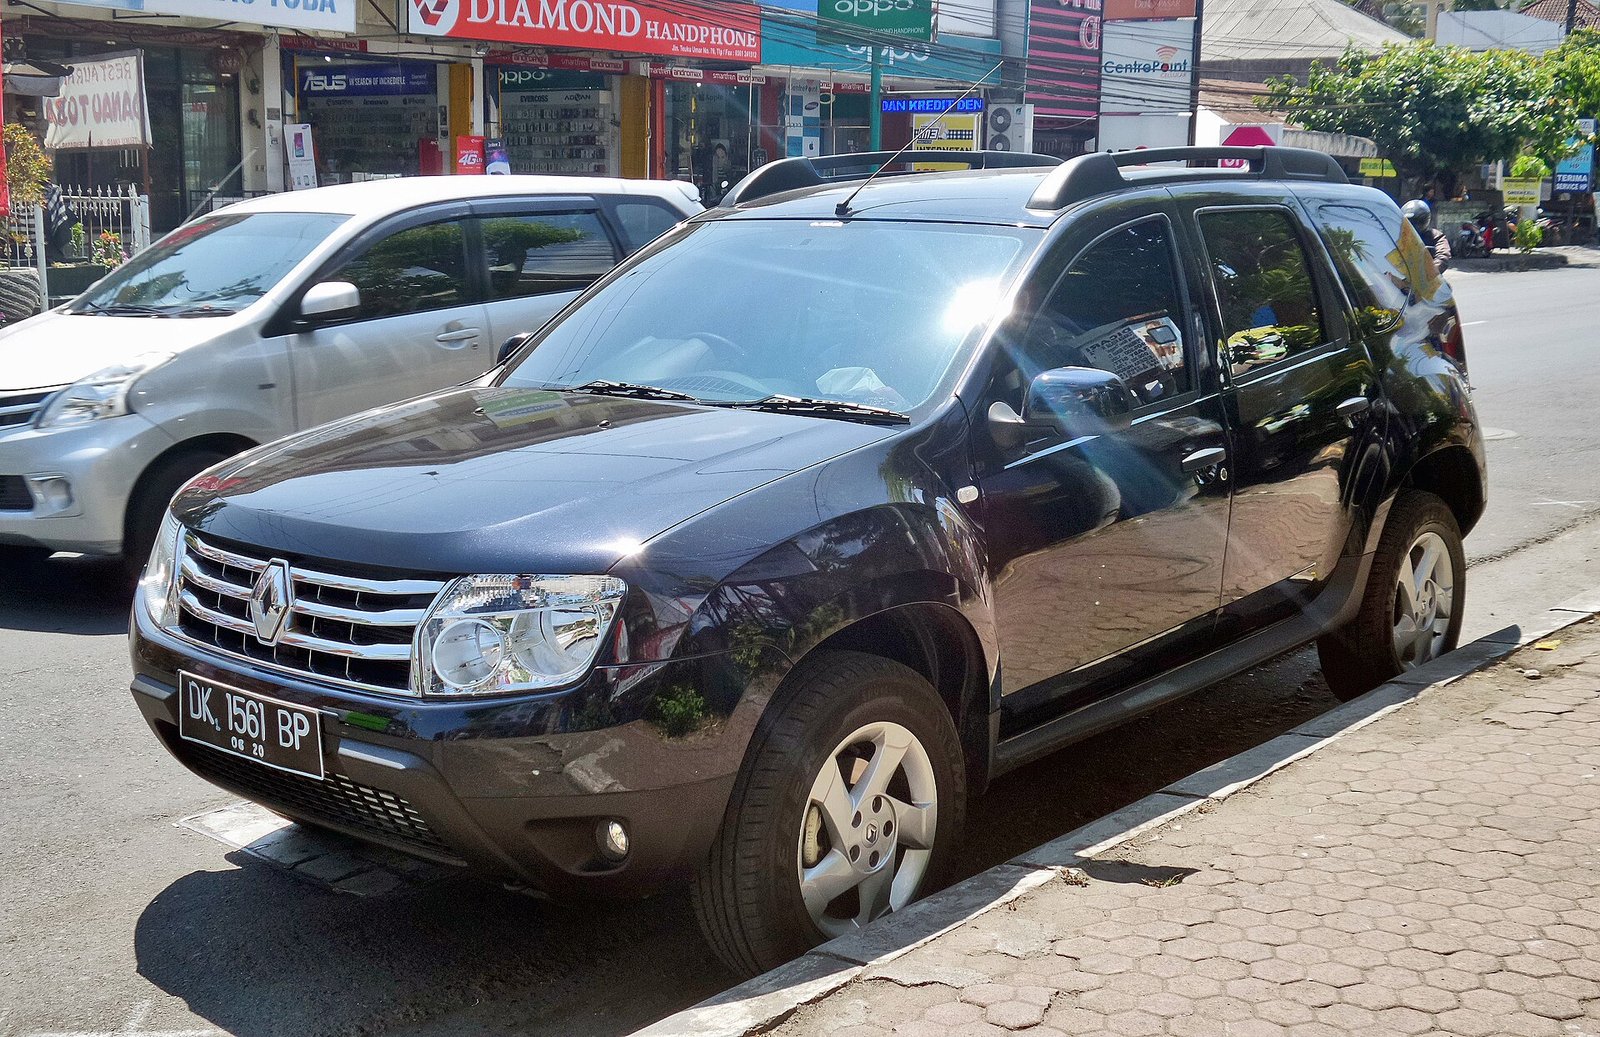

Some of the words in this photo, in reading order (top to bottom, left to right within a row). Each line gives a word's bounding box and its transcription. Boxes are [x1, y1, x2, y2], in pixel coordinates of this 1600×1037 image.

[467, 0, 641, 37] DIAMOND
[645, 20, 757, 48] HANDPHONE
[561, 58, 589, 67] smartfren
[1103, 59, 1187, 74] CentroPoint
[303, 74, 346, 91] ASUS
[355, 78, 372, 86] SEARCH
[373, 77, 379, 86] OF
[713, 72, 736, 80] smartfren
[882, 100, 906, 111] DAN
[459, 154, 478, 165] 4G
[1556, 174, 1588, 182] TERIMA
[188, 680, 215, 726] DK
[226, 692, 266, 742] 1561
[277, 708, 310, 751] BP
[252, 742, 265, 758] 20
